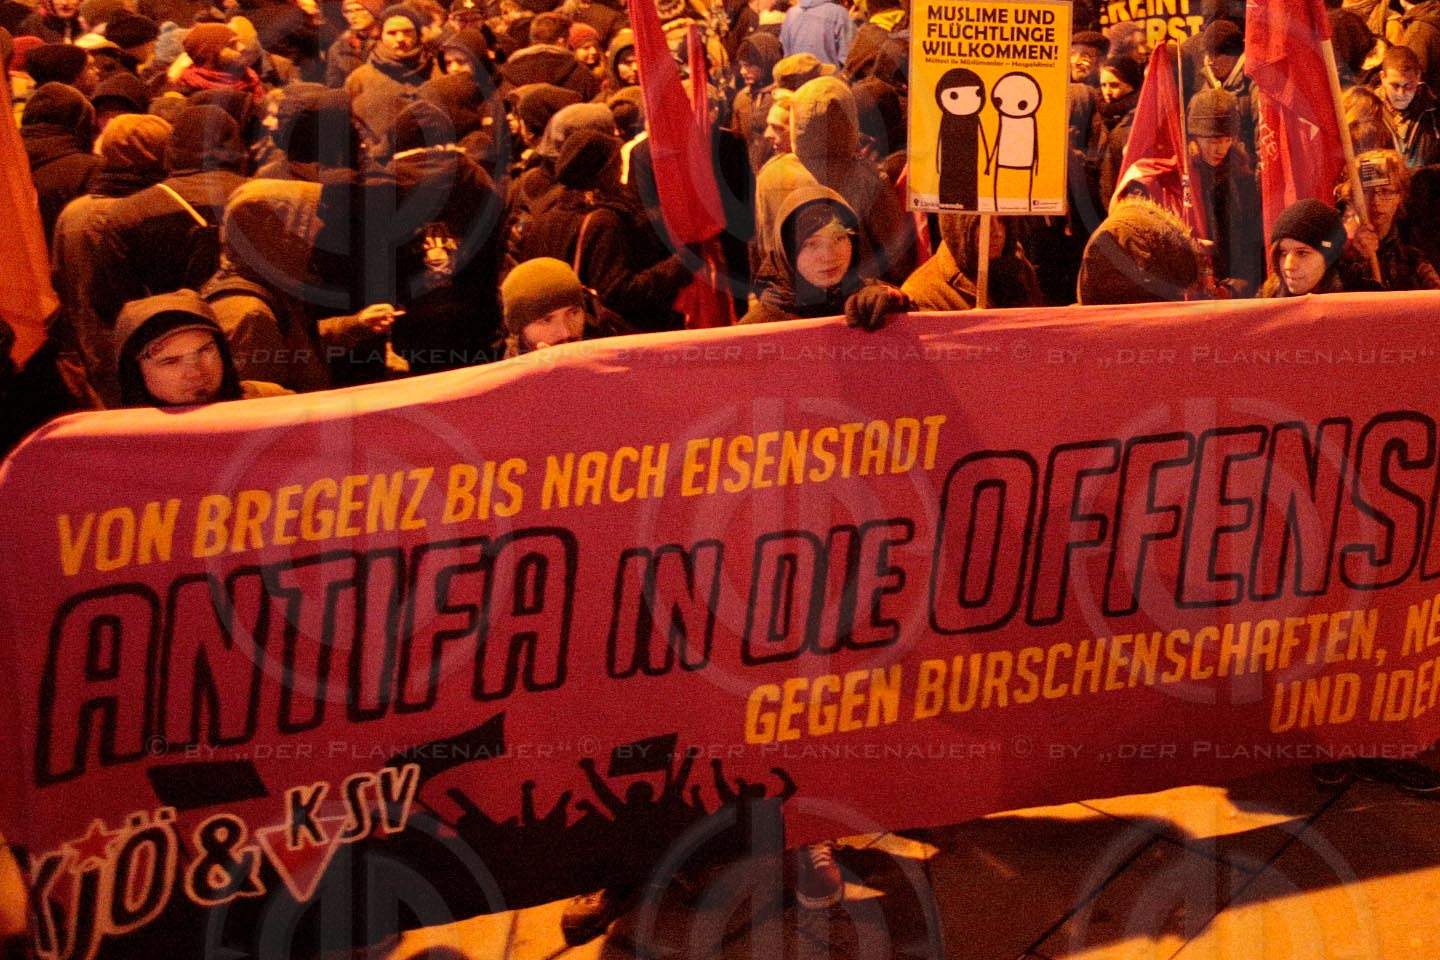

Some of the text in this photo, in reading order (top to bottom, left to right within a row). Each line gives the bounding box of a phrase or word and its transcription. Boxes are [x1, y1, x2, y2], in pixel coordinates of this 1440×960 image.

[922, 41, 1058, 61] WILLKOMMEN!
[927, 5, 1055, 24] MUSLIME UND
[927, 22, 1055, 43] FLÜCHTLINGE
[57, 415, 946, 576] VON BREGENZ BIS NACH EISENSTADT
[40, 528, 578, 786] ANTIFA
[606, 539, 725, 678] IN
[740, 519, 915, 667] DIE
[744, 663, 898, 744] GEGEN
[913, 609, 1387, 721] BURSCHENSCHAFTEN,
[1269, 672, 1362, 733] UND
[184, 814, 266, 905] &
[285, 764, 421, 850] KSV
